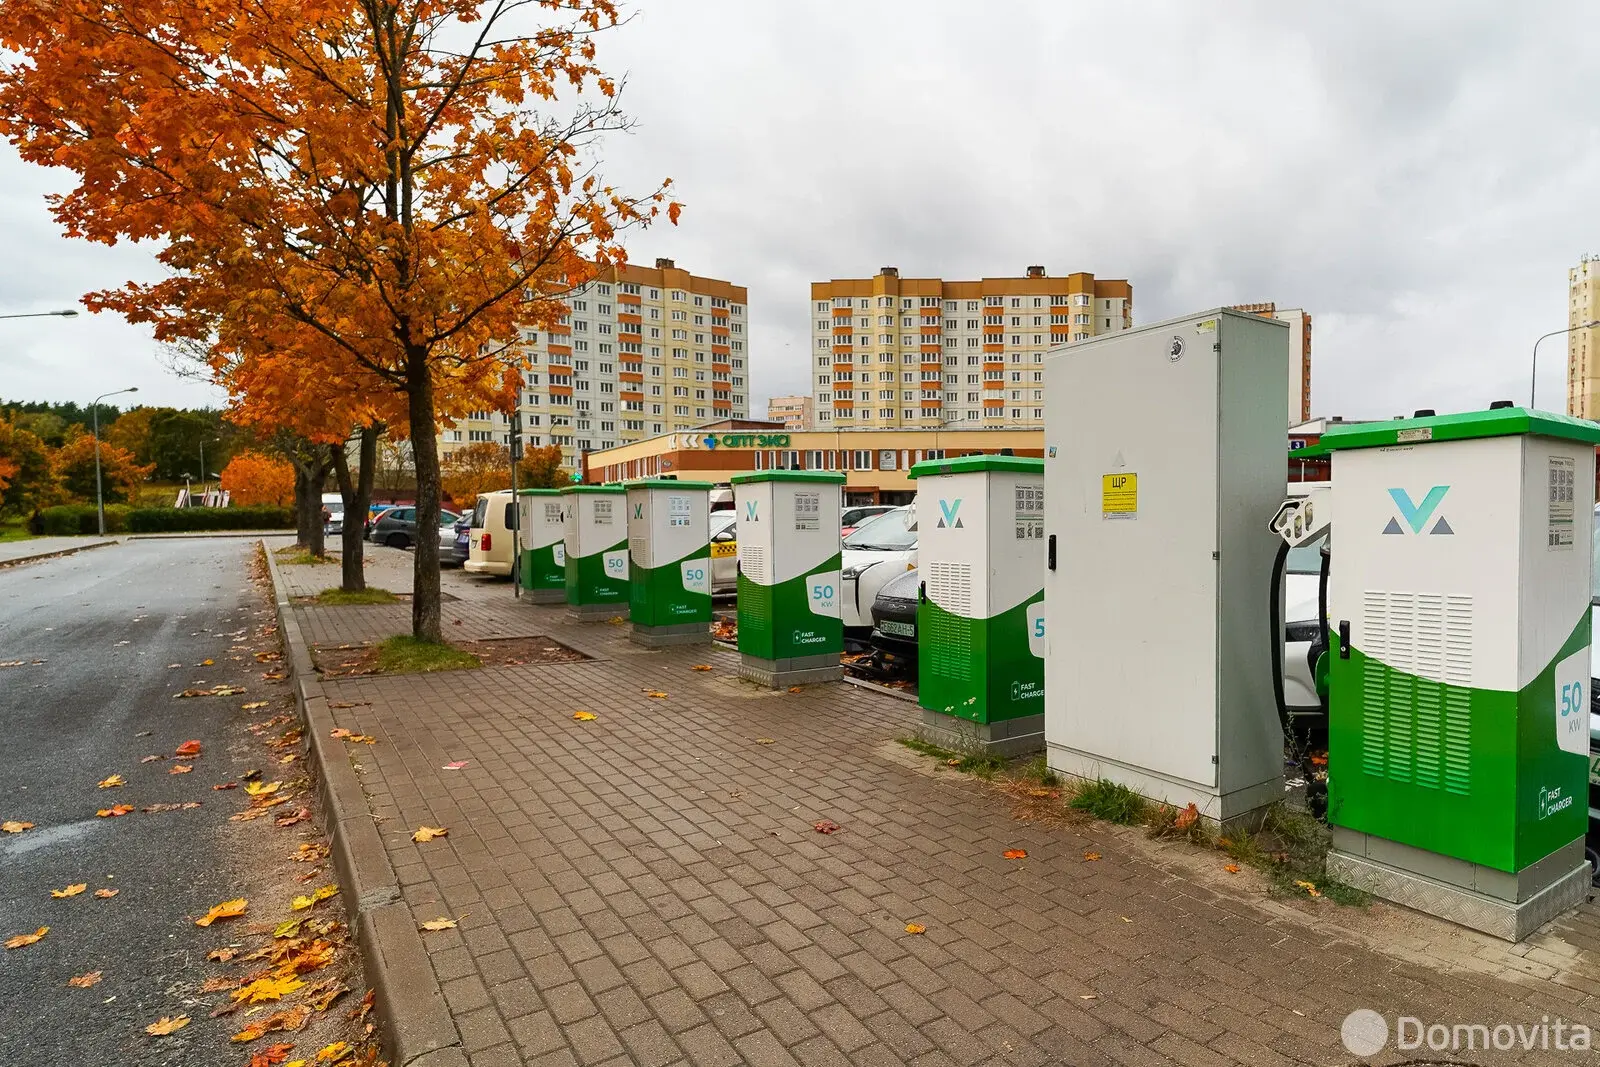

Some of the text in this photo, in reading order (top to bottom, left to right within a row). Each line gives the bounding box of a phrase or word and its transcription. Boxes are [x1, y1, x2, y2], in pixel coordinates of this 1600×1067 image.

[1112, 477, 1127, 489] ЩР
[608, 558, 623, 568] 50
[686, 569, 704, 580] 50
[813, 585, 834, 599] 50
[1034, 617, 1045, 638] 5
[1020, 682, 1035, 690] FAST
[1020, 690, 1044, 699] CHARGE
[1561, 681, 1582, 717] 50
[1569, 718, 1581, 734] KW
[1547, 787, 1561, 802] FAST
[1547, 795, 1573, 816] CHARGER
